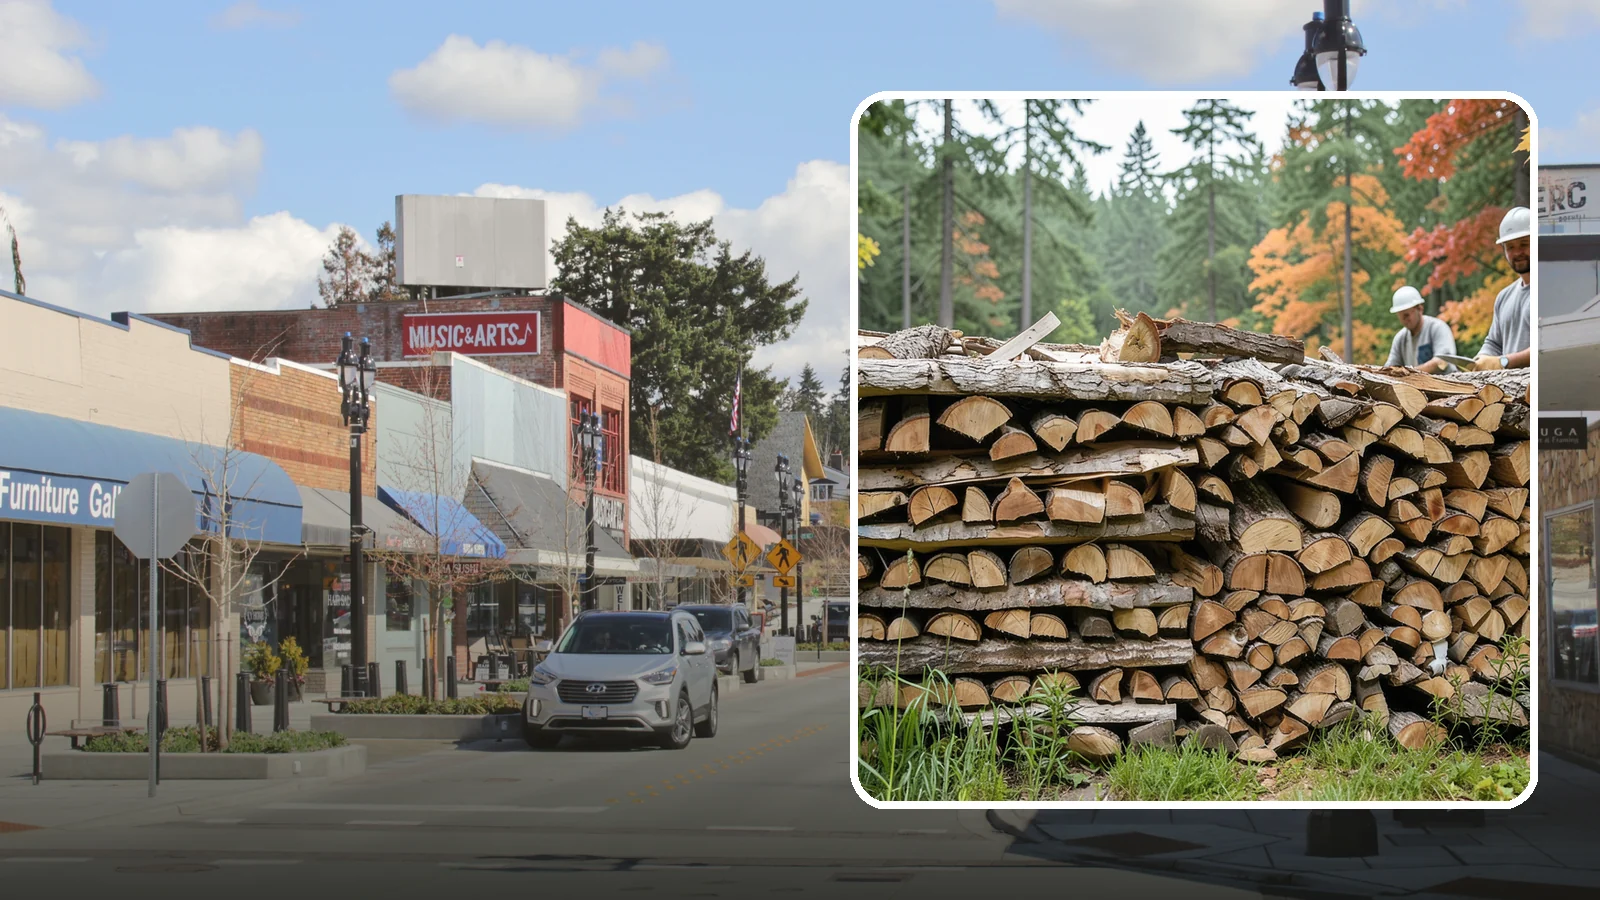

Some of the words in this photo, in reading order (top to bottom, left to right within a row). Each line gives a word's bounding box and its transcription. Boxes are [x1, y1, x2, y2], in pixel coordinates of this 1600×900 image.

[408, 322, 521, 349] MUSIC&ARTS
[1540, 427, 1578, 437] UGA
[0, 471, 79, 515] Furniture
[89, 482, 122, 519] Gal
